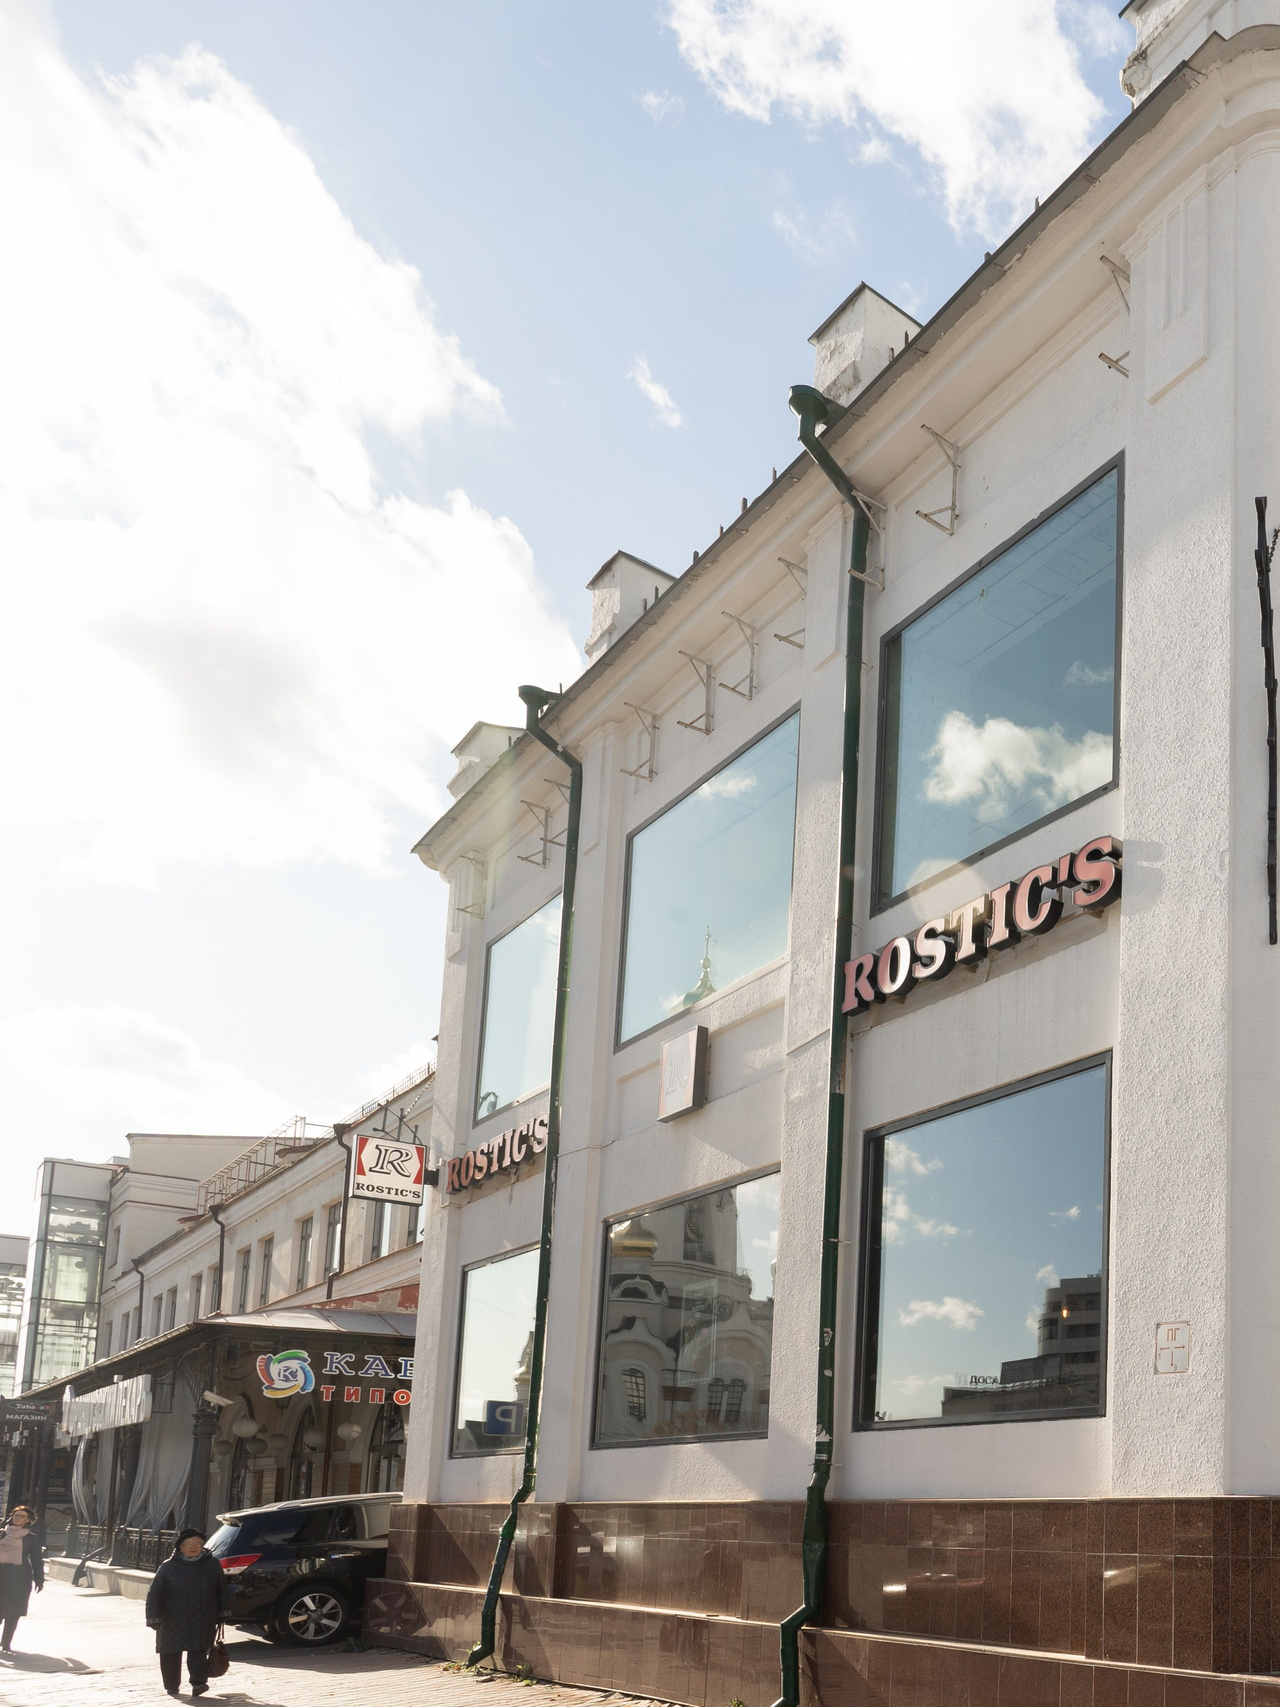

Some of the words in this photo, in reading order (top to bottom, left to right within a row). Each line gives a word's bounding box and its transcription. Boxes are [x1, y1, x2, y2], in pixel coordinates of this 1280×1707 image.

[842, 836, 1121, 1016] ROSTIC'S
[369, 1144, 413, 1177] R
[446, 1112, 549, 1194] ROSTIC'S
[356, 1183, 420, 1199] ROSTIC'S
[1167, 1328, 1180, 1342] ПГ
